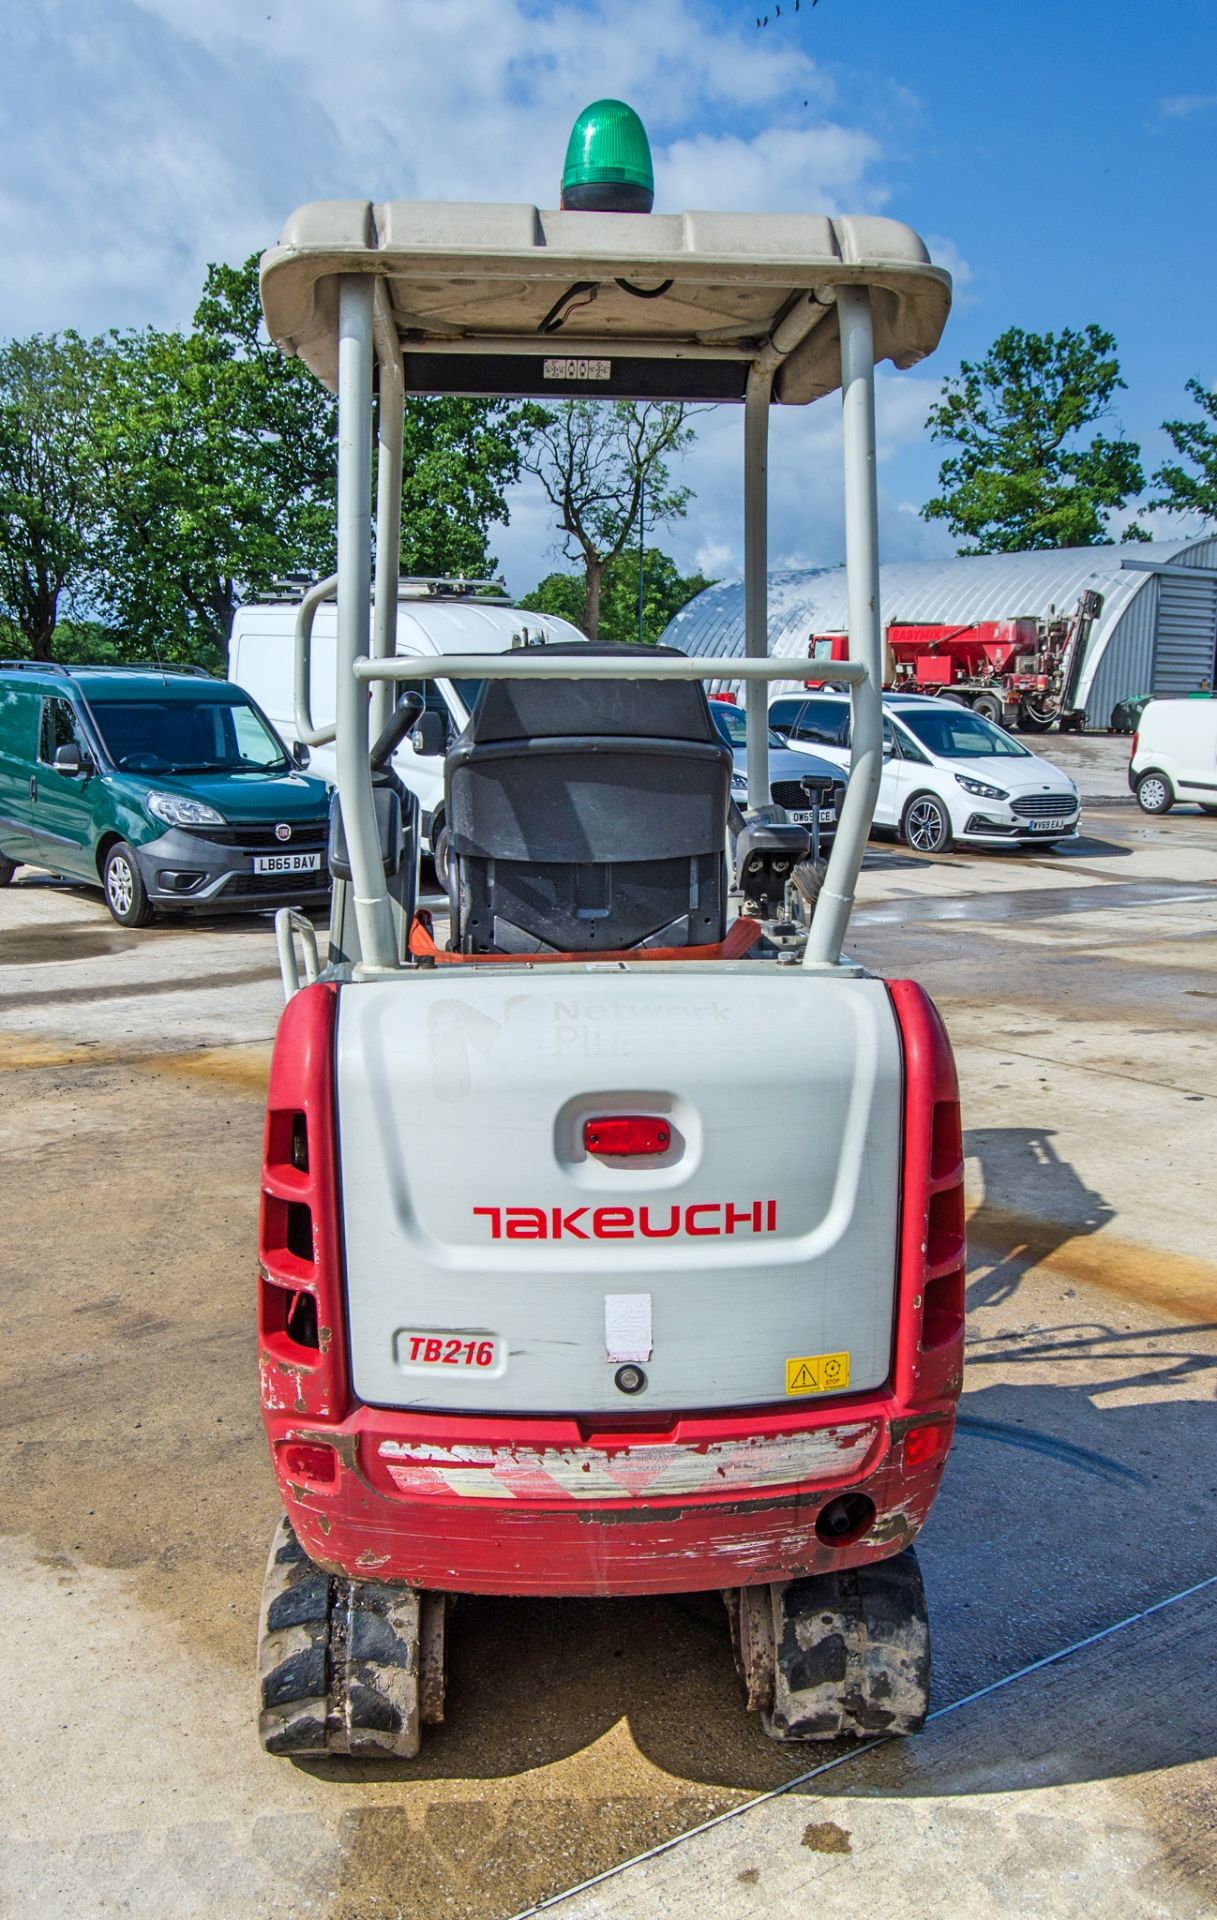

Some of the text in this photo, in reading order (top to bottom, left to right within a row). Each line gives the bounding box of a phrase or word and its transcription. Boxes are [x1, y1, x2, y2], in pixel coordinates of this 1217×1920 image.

[819, 811, 831, 821] CE
[1033, 819, 1064, 829] WV69 EAJ
[260, 855, 316, 871] LB65 BAV
[473, 1200, 776, 1239] TAKEUCHI
[409, 1337, 494, 1367] TB216
